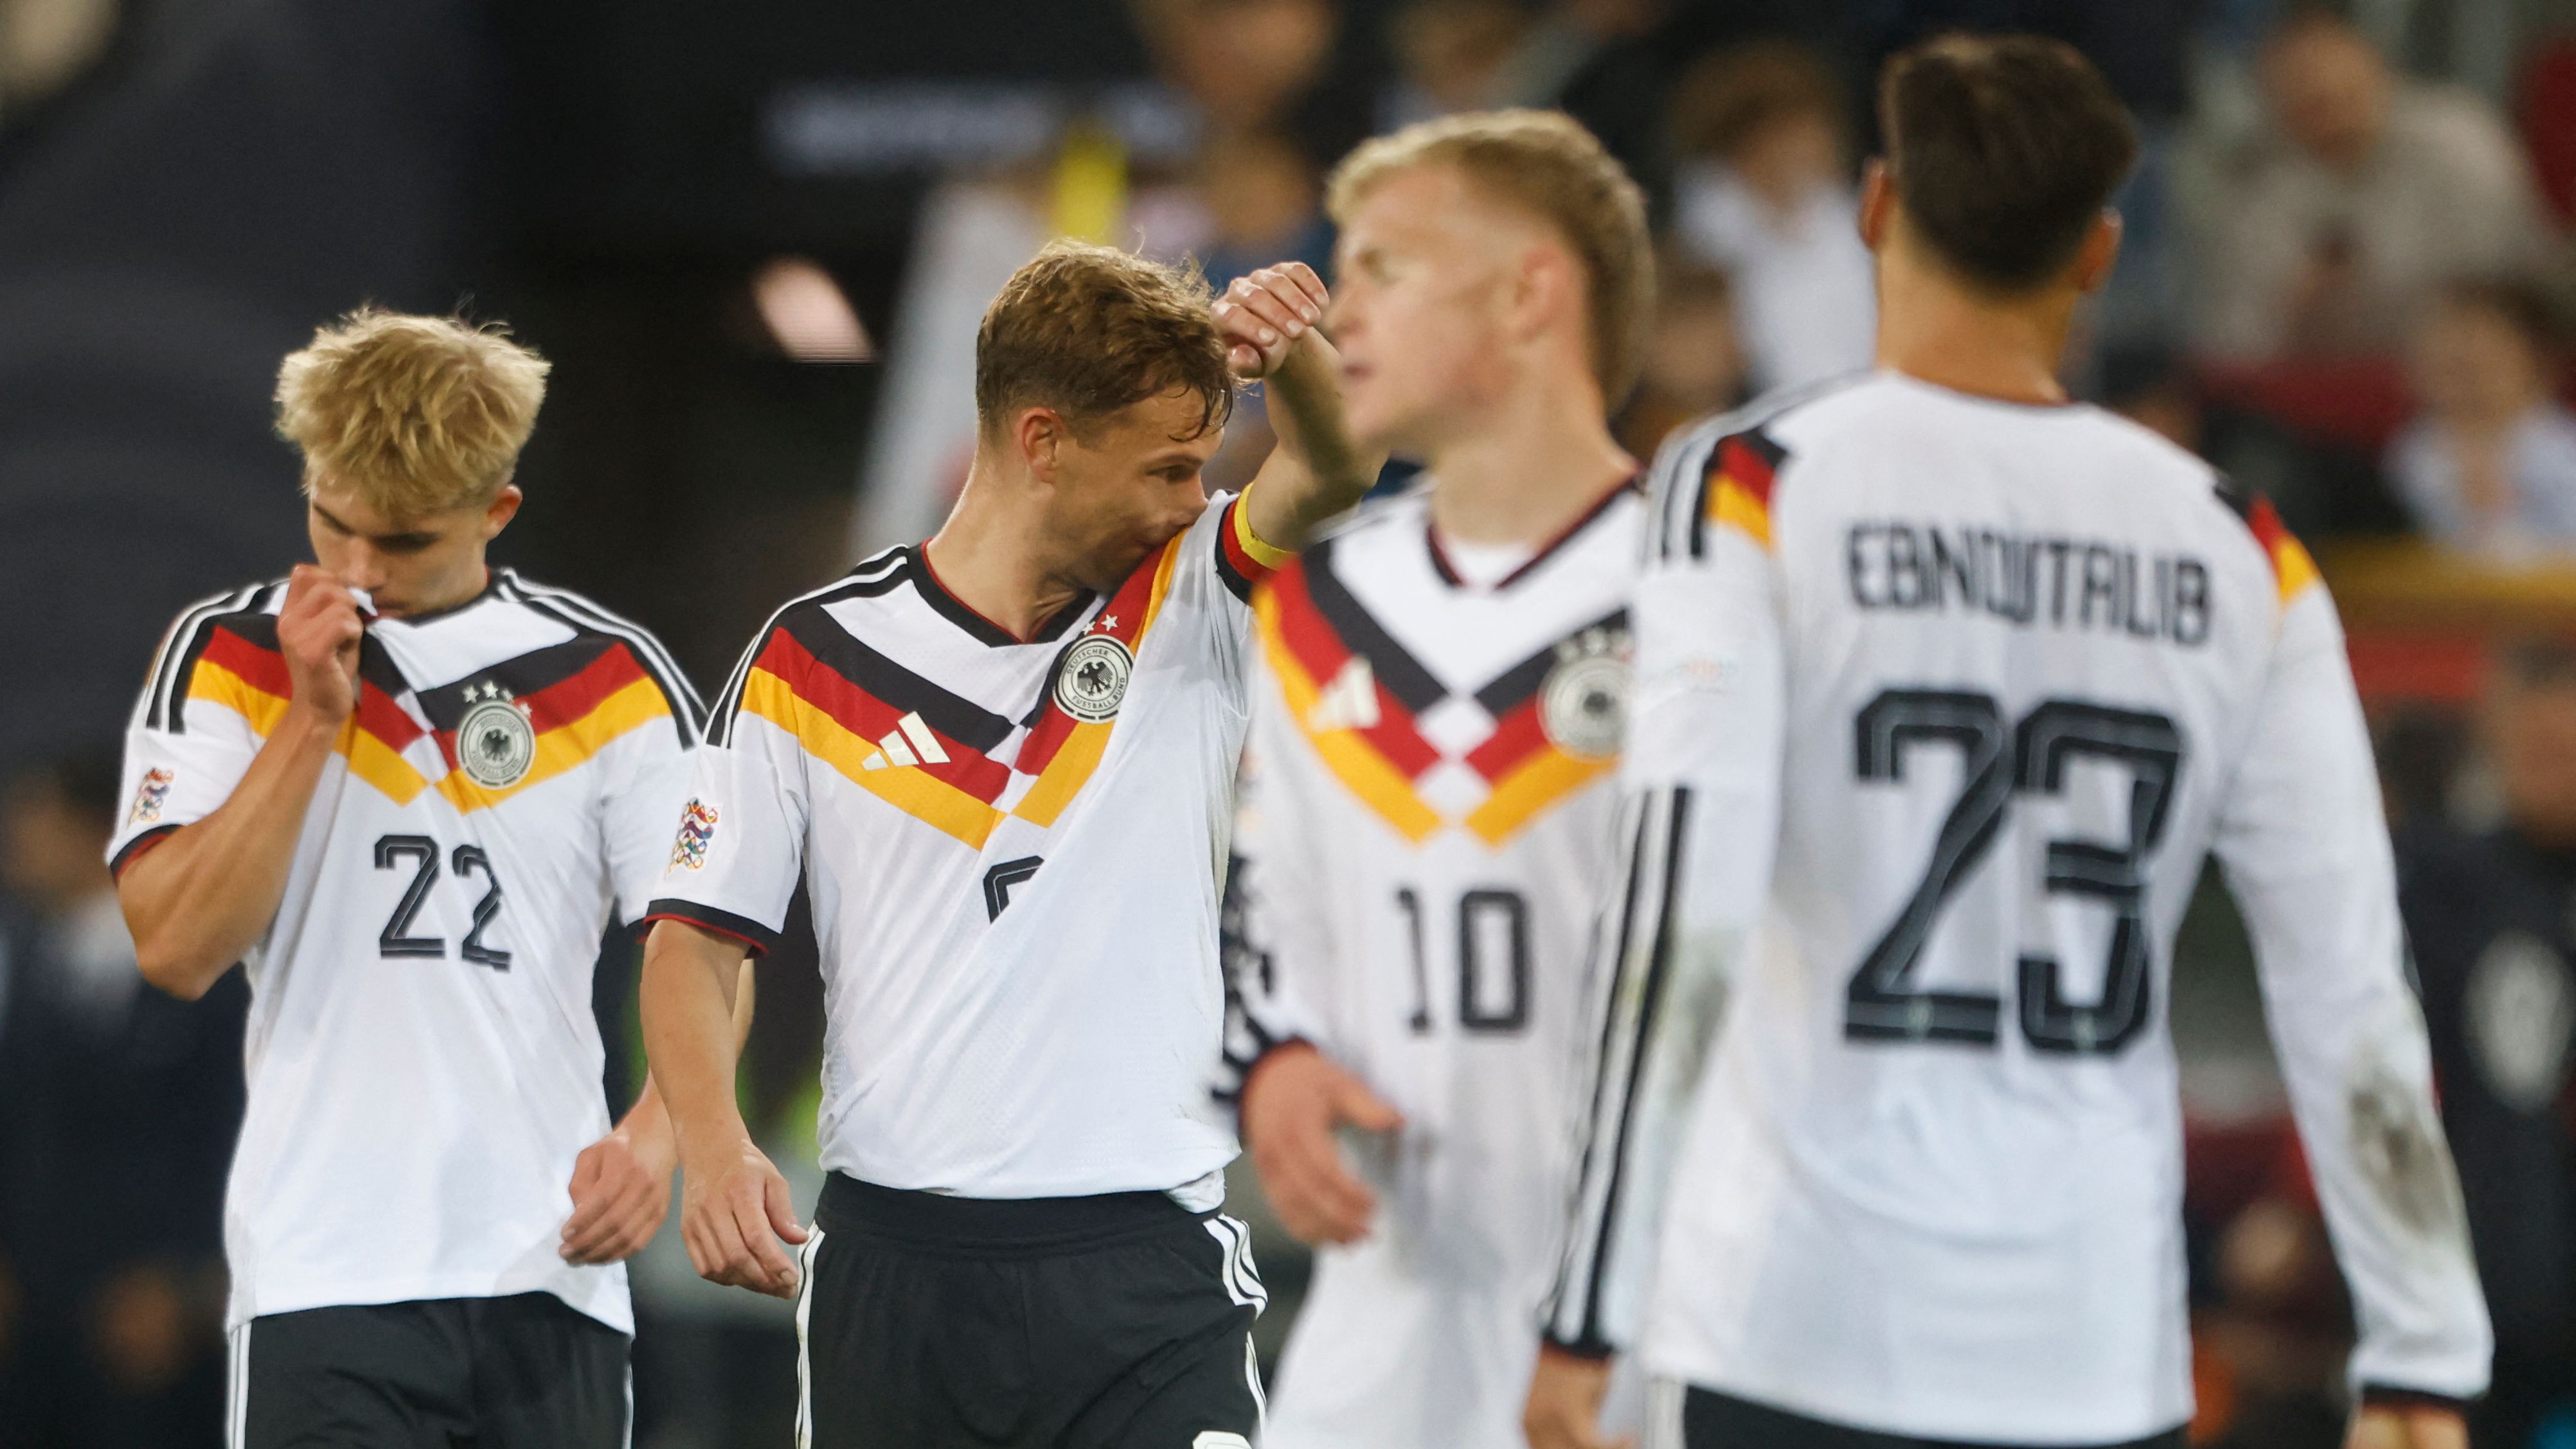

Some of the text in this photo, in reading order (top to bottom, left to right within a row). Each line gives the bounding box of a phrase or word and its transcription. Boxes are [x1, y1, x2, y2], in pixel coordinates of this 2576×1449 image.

[374, 834, 512, 972] 22
[1846, 689, 2183, 1056] 23
[1395, 887, 1530, 1033] 10
